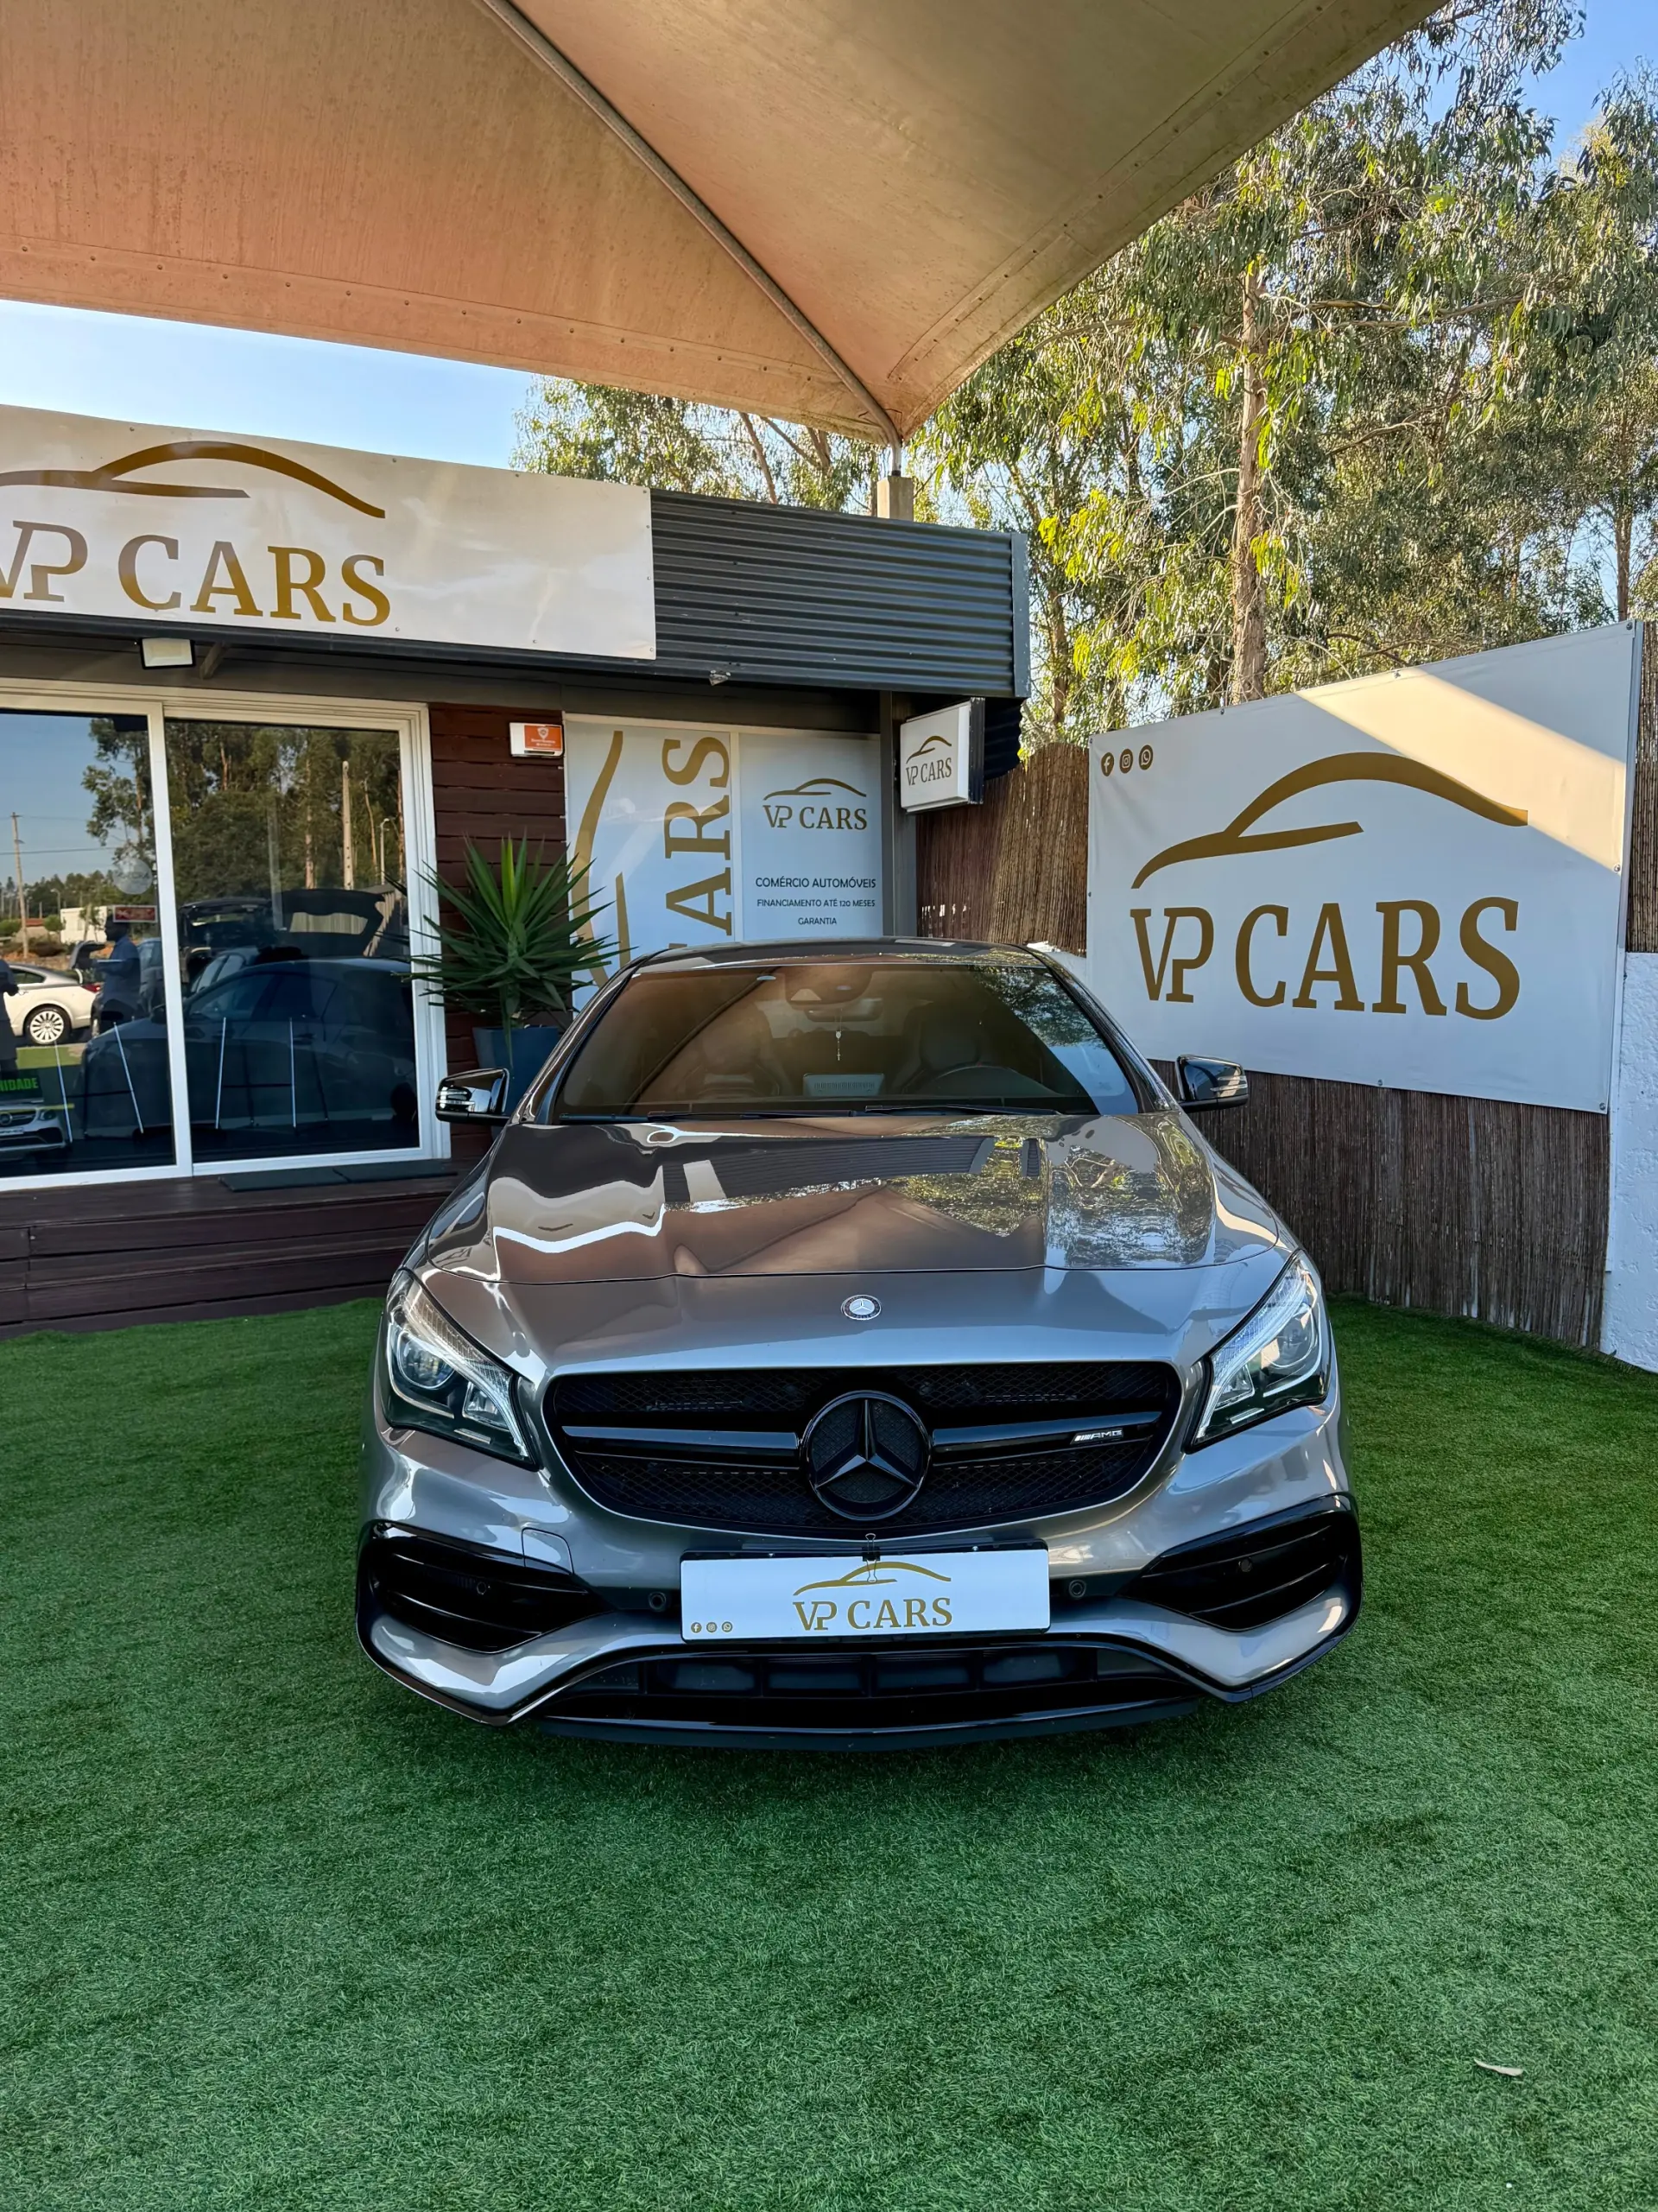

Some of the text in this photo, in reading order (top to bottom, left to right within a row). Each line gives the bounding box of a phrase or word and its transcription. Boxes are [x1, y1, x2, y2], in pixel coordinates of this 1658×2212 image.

[117, 535, 391, 628] CARS
[905, 757, 952, 787] VP CARS
[763, 805, 867, 830] VP CARS
[661, 737, 732, 948] ARS
[755, 876, 876, 889] COMÉRCIO AUTOMÓVEIS
[756, 898, 822, 907] FINANCIAMENTO
[823, 897, 838, 907] ATÉ
[1130, 896, 1522, 1020] VP CARS
[792, 1597, 952, 1631] VP CARS
